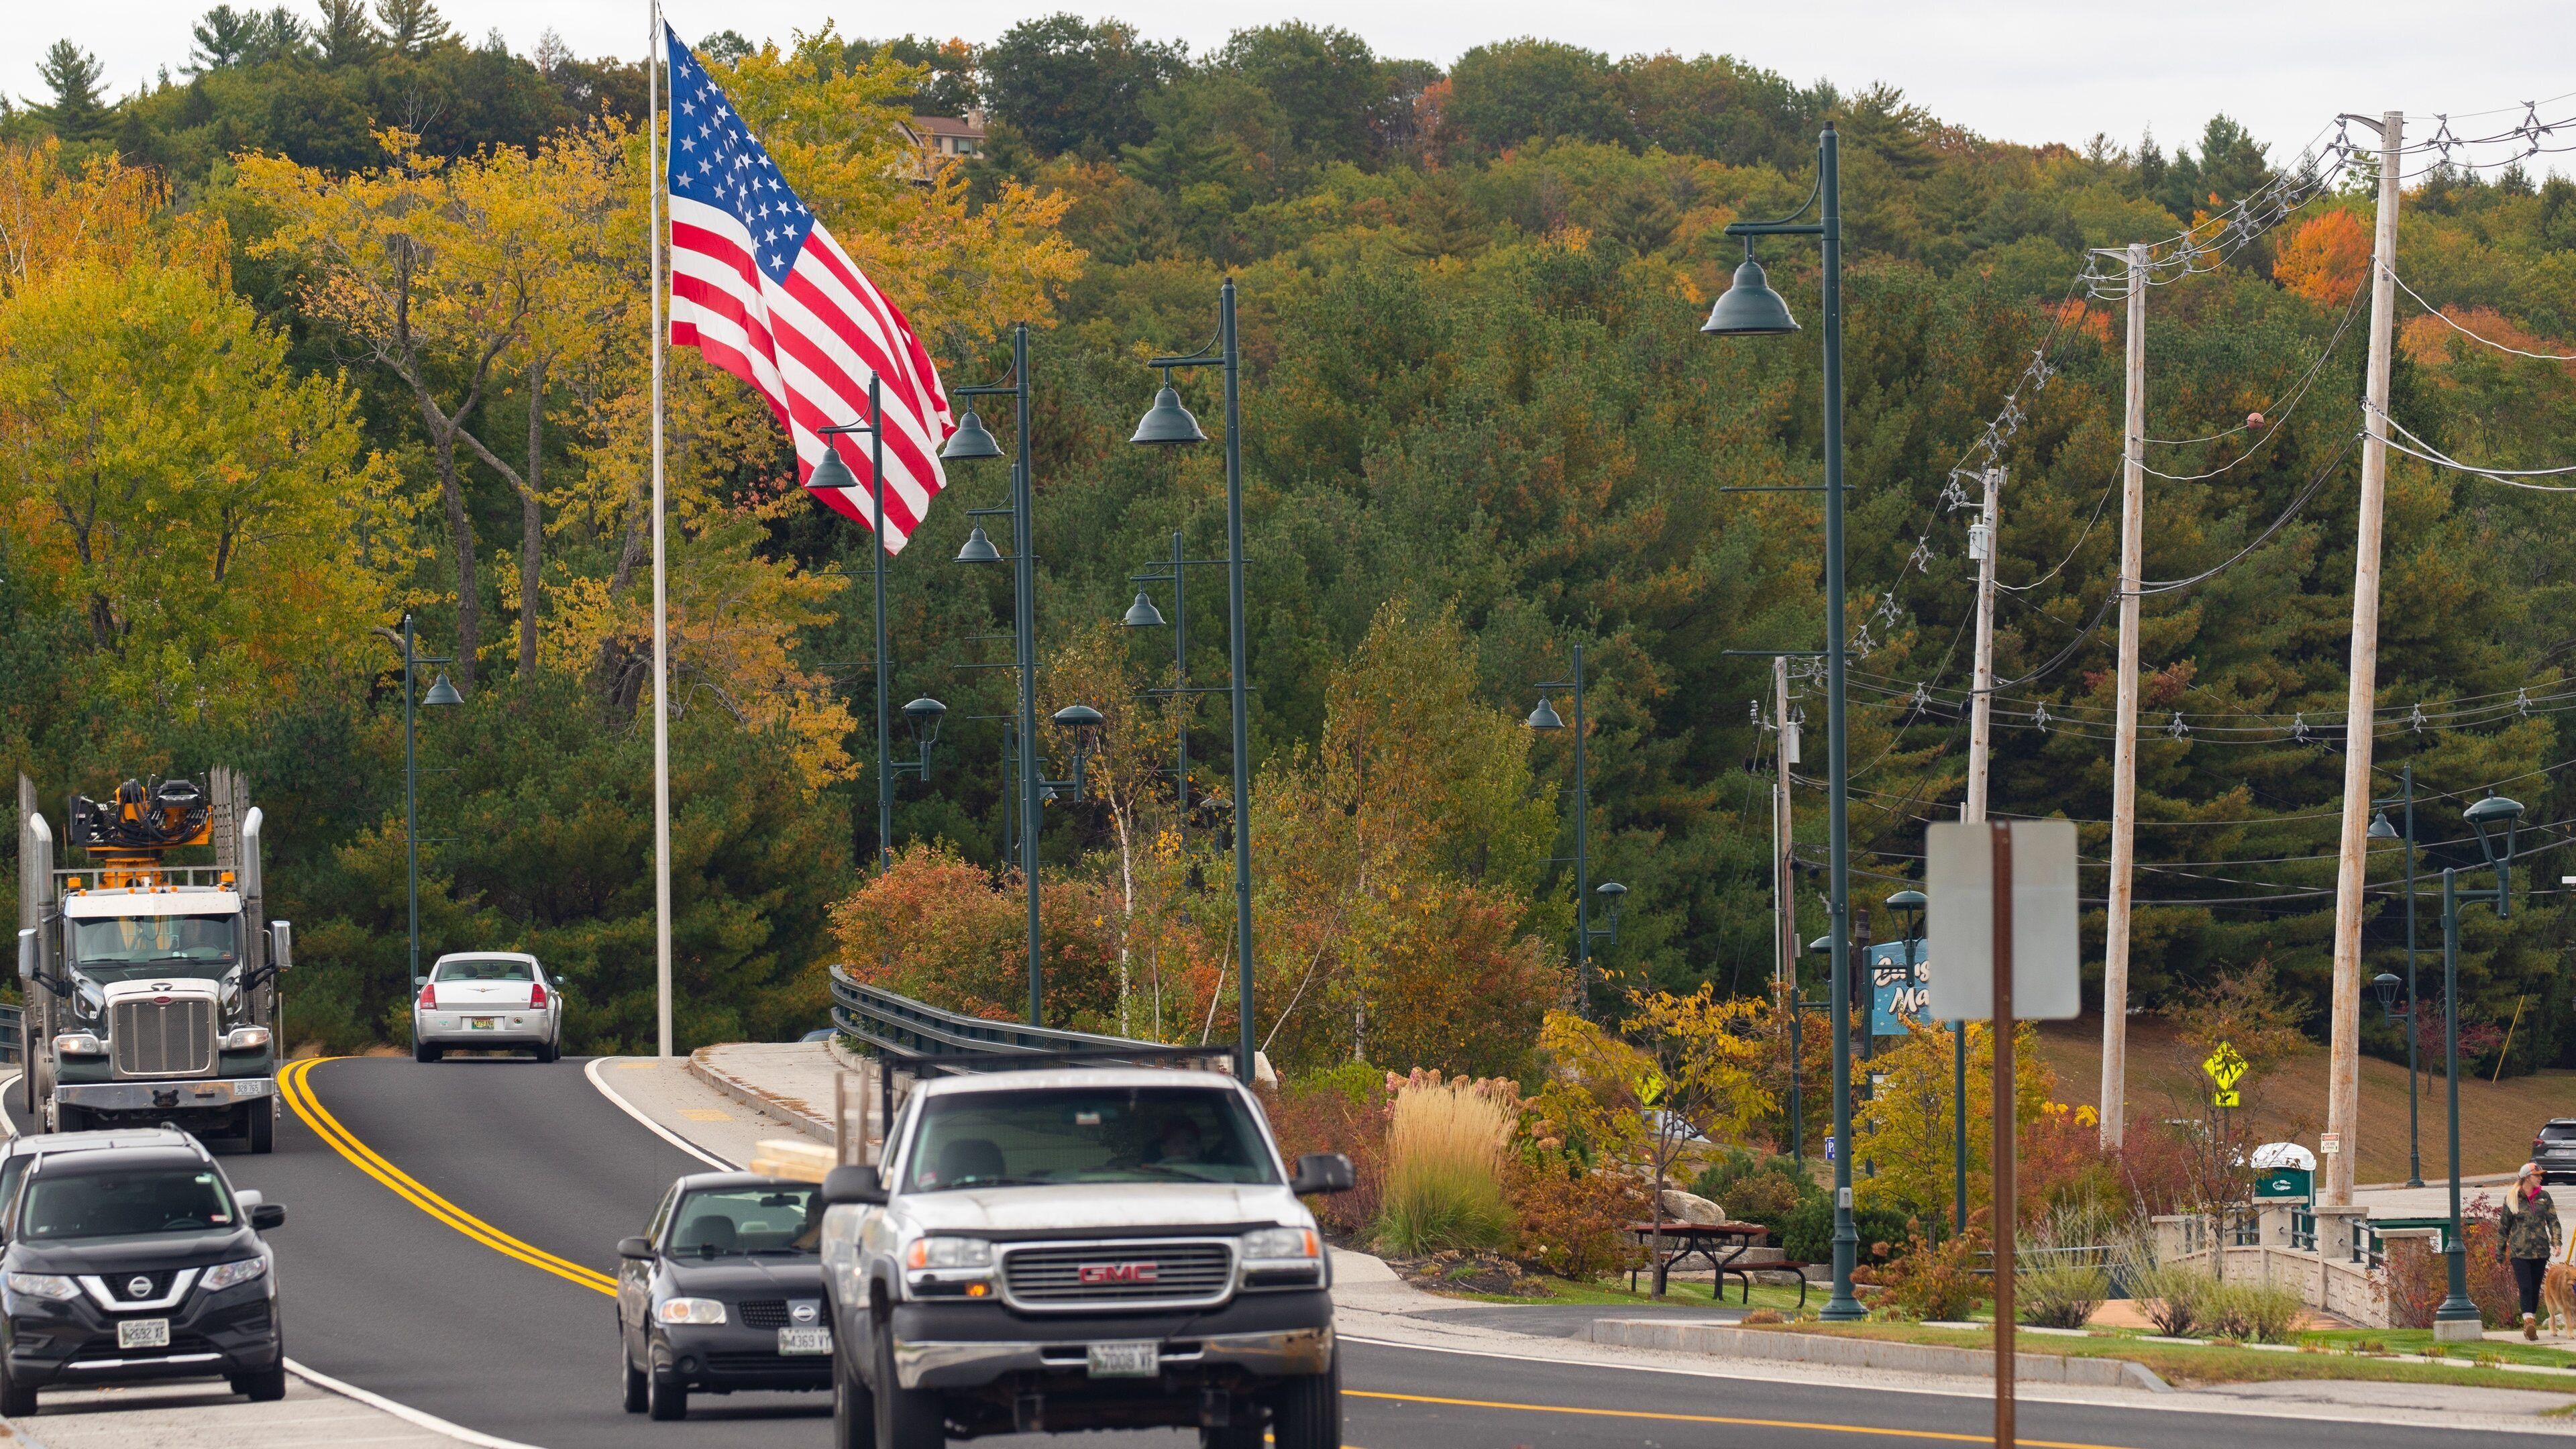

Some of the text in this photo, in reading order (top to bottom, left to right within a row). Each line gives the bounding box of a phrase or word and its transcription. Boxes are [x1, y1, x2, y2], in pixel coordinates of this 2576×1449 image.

[237, 1084, 259, 1093] 928 765
[1079, 1262, 1158, 1284] GMC
[790, 1335, 814, 1348] 4369
